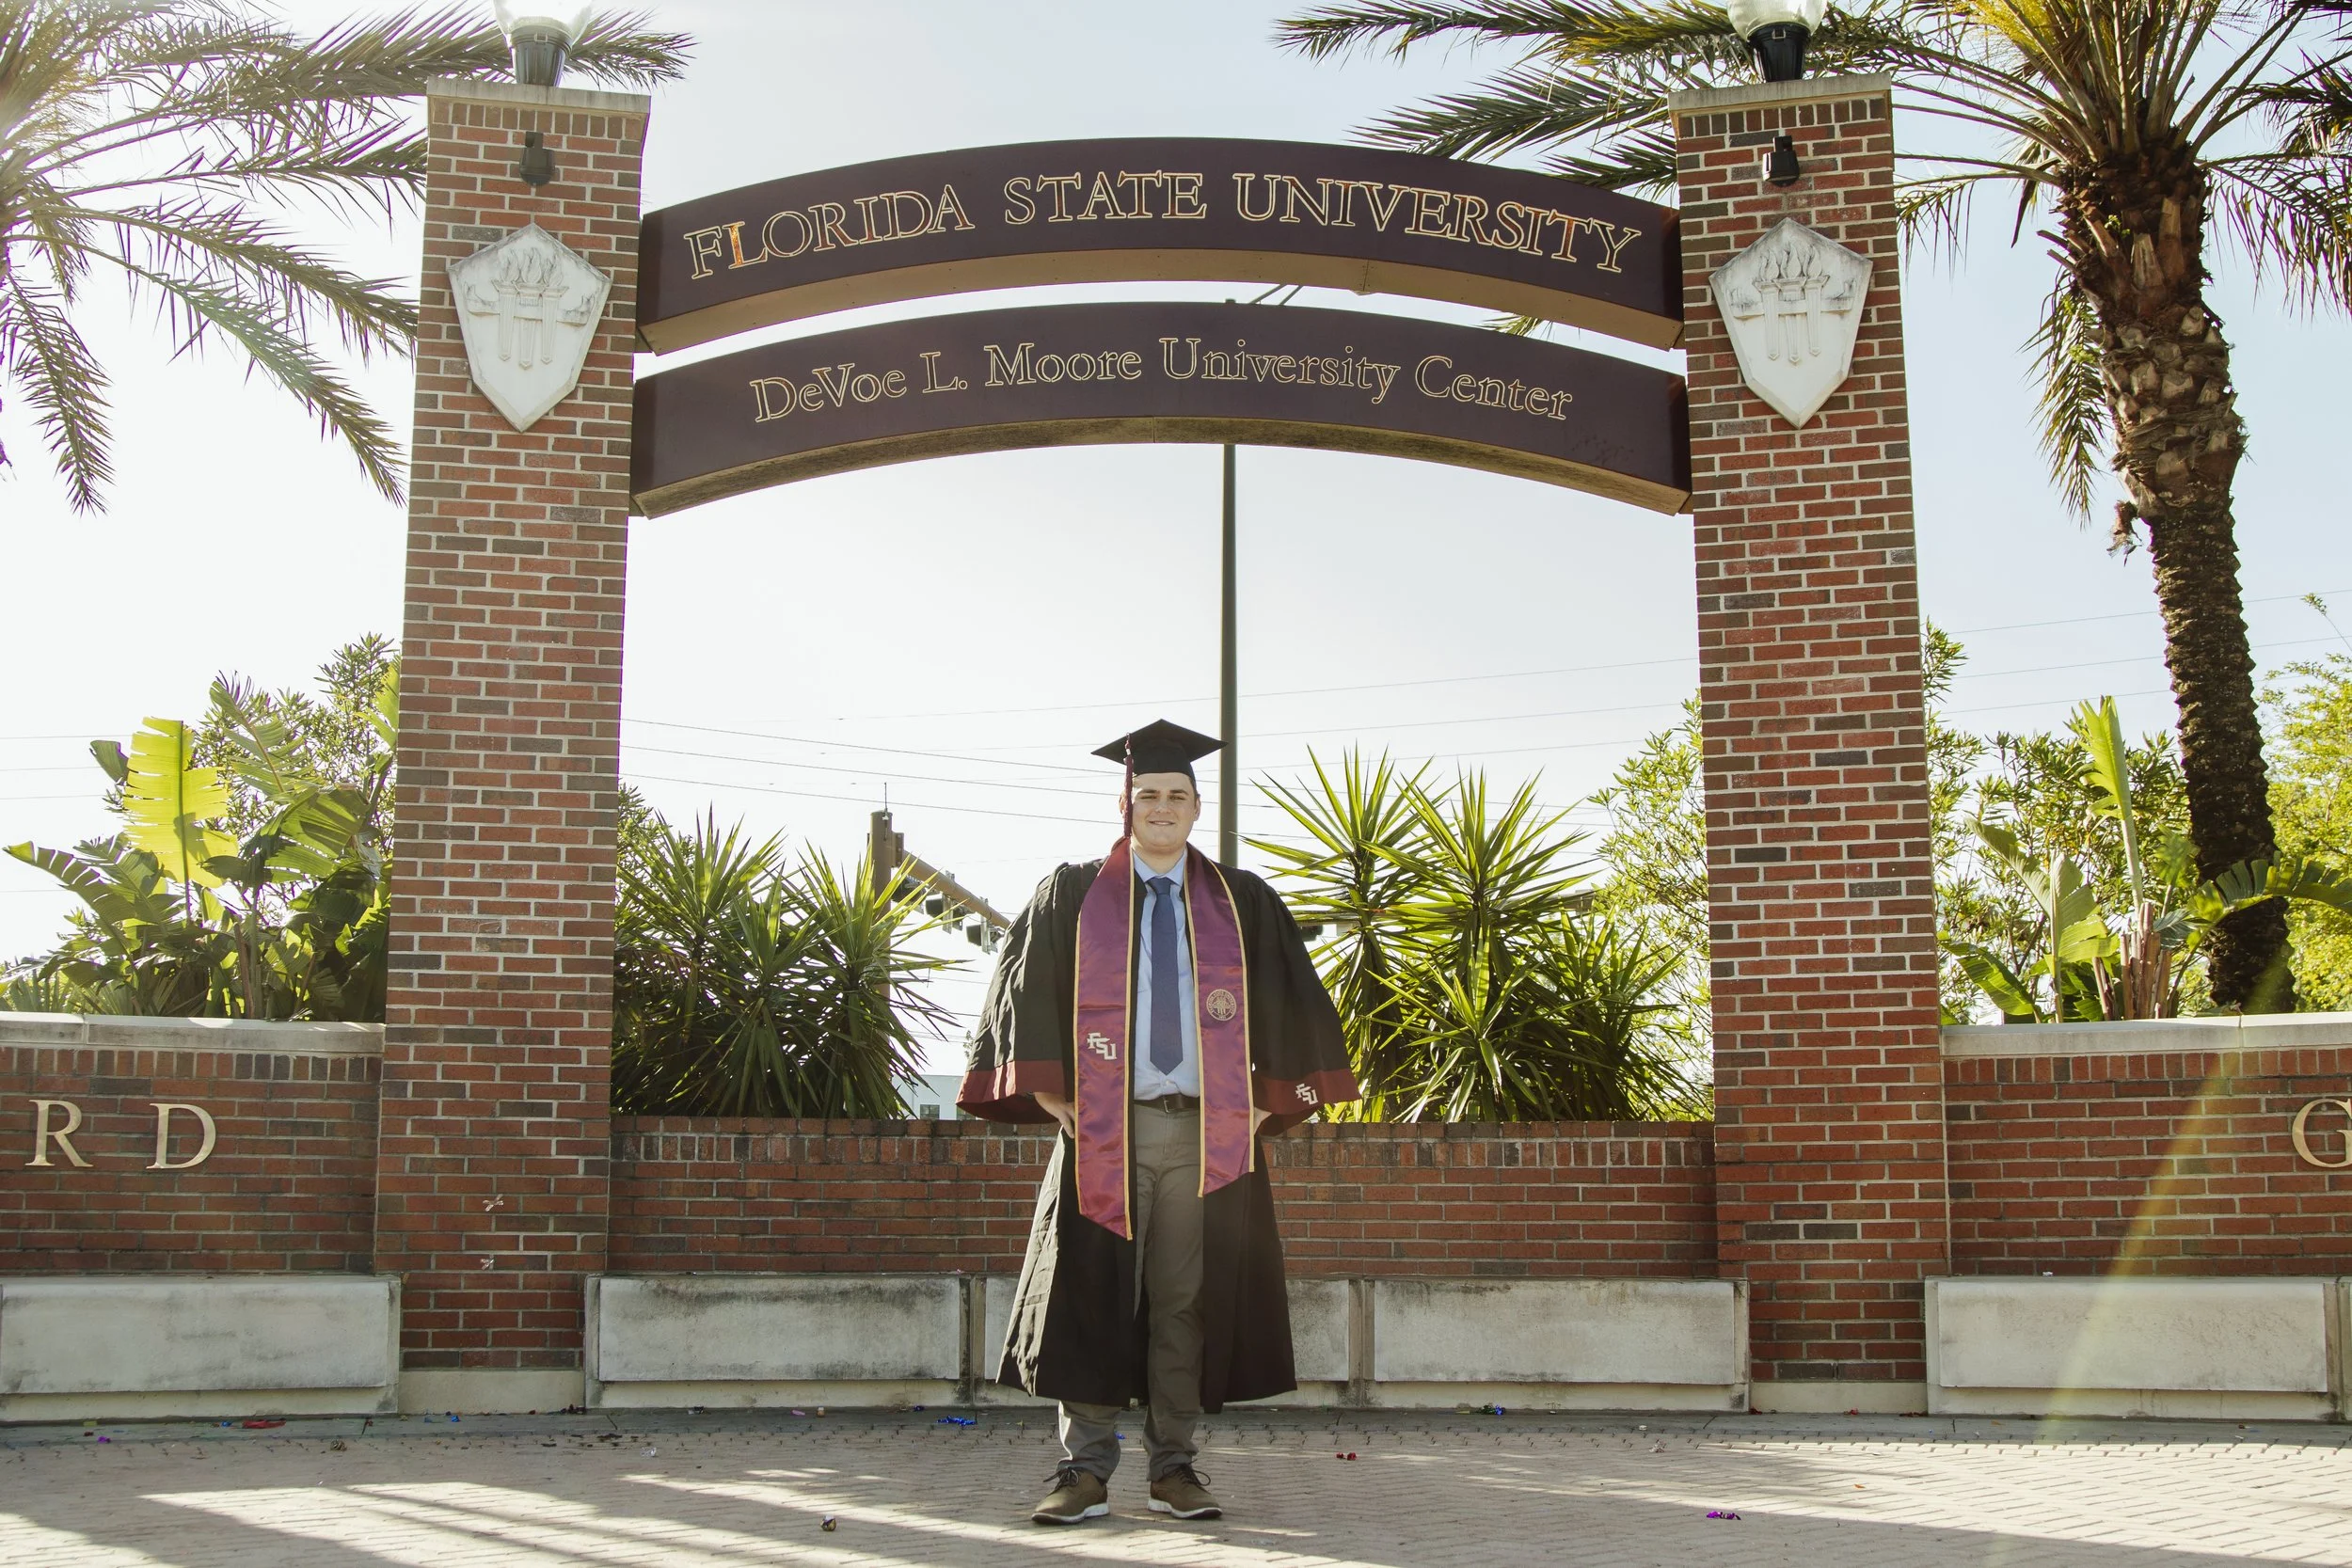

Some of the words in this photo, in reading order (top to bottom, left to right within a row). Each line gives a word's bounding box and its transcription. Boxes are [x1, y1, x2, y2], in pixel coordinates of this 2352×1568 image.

[683, 183, 976, 279] FLORIDA
[1003, 169, 1208, 225] STATE
[1232, 172, 1643, 274] UNIVERSITY
[750, 363, 907, 422] DeVoe
[920, 351, 968, 393] L.
[983, 342, 1142, 387] Moore
[1158, 337, 1401, 404] University
[1415, 355, 1574, 420] Center
[1087, 1032, 1118, 1060] FSU
[1295, 1083, 1319, 1105] FSU
